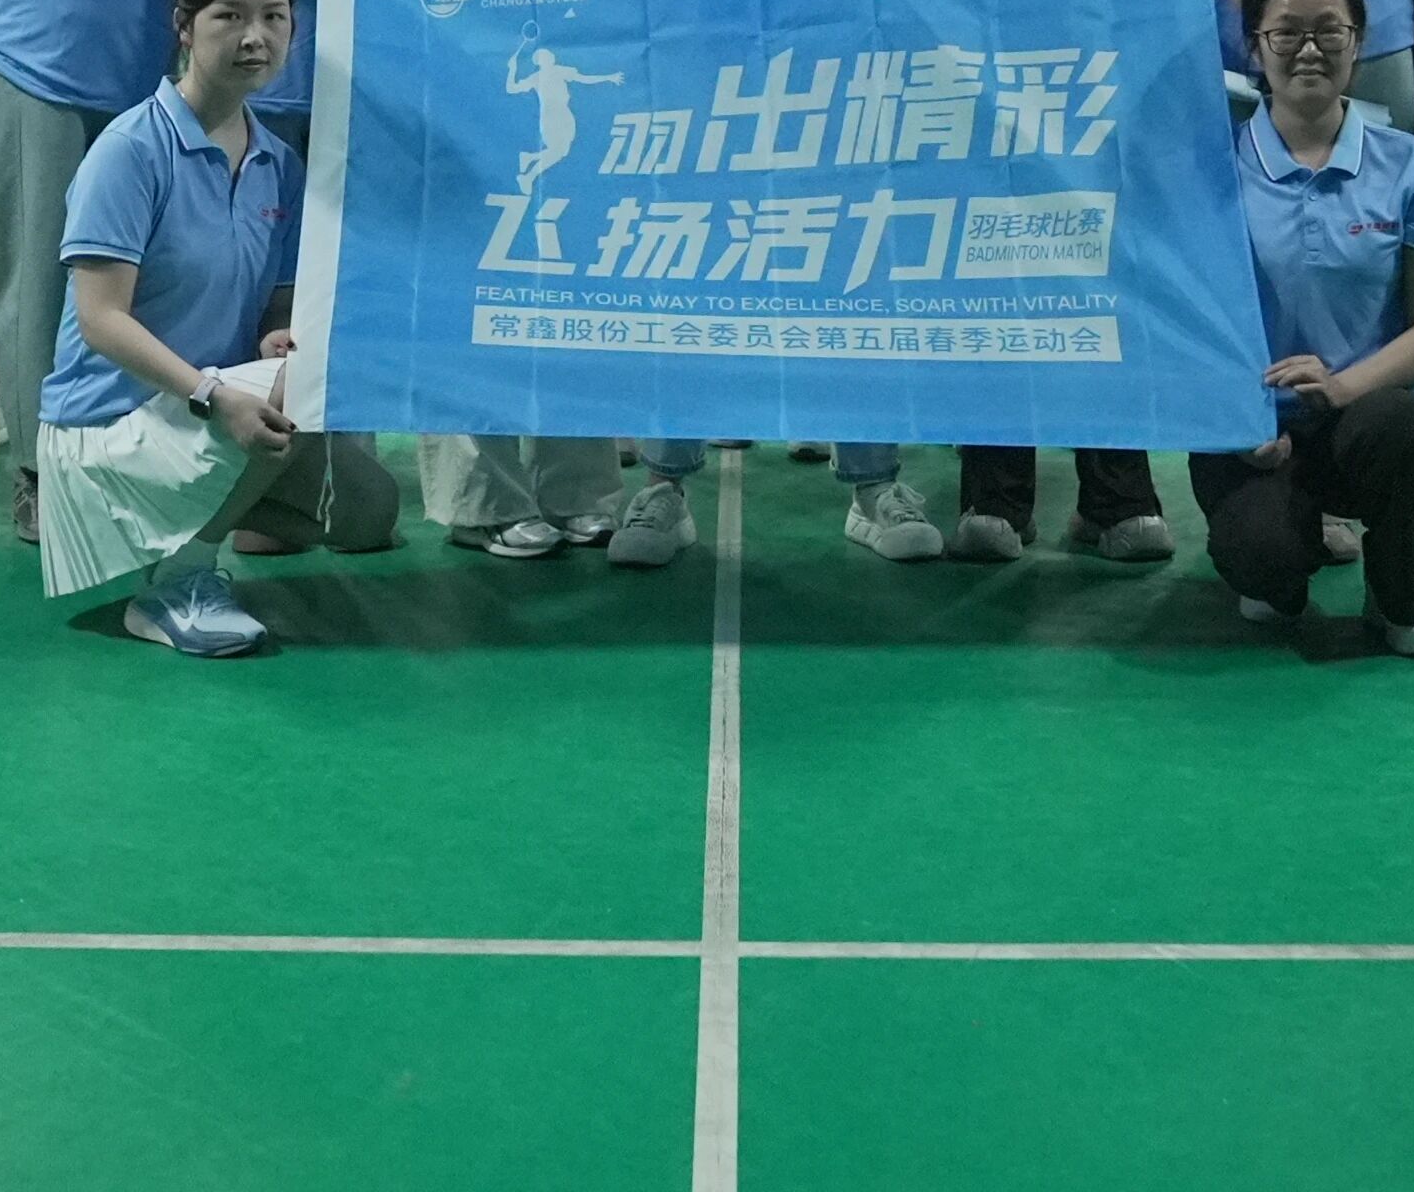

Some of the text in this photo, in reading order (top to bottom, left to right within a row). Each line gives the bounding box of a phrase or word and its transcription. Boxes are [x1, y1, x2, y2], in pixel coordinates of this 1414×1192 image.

[598, 45, 1119, 175] 羽出精彩
[968, 208, 1106, 239] 羽毛球比赛
[477, 189, 956, 294] 飞扬活力
[966, 240, 1103, 263] BADMINTON MATCH
[475, 286, 1118, 313] FEATHER YOUR WAY TO EXCELLENCE, SOAR WITH VITALITY
[489, 313, 1101, 353] 常鑫股份工会委员会第五届春季运动会
